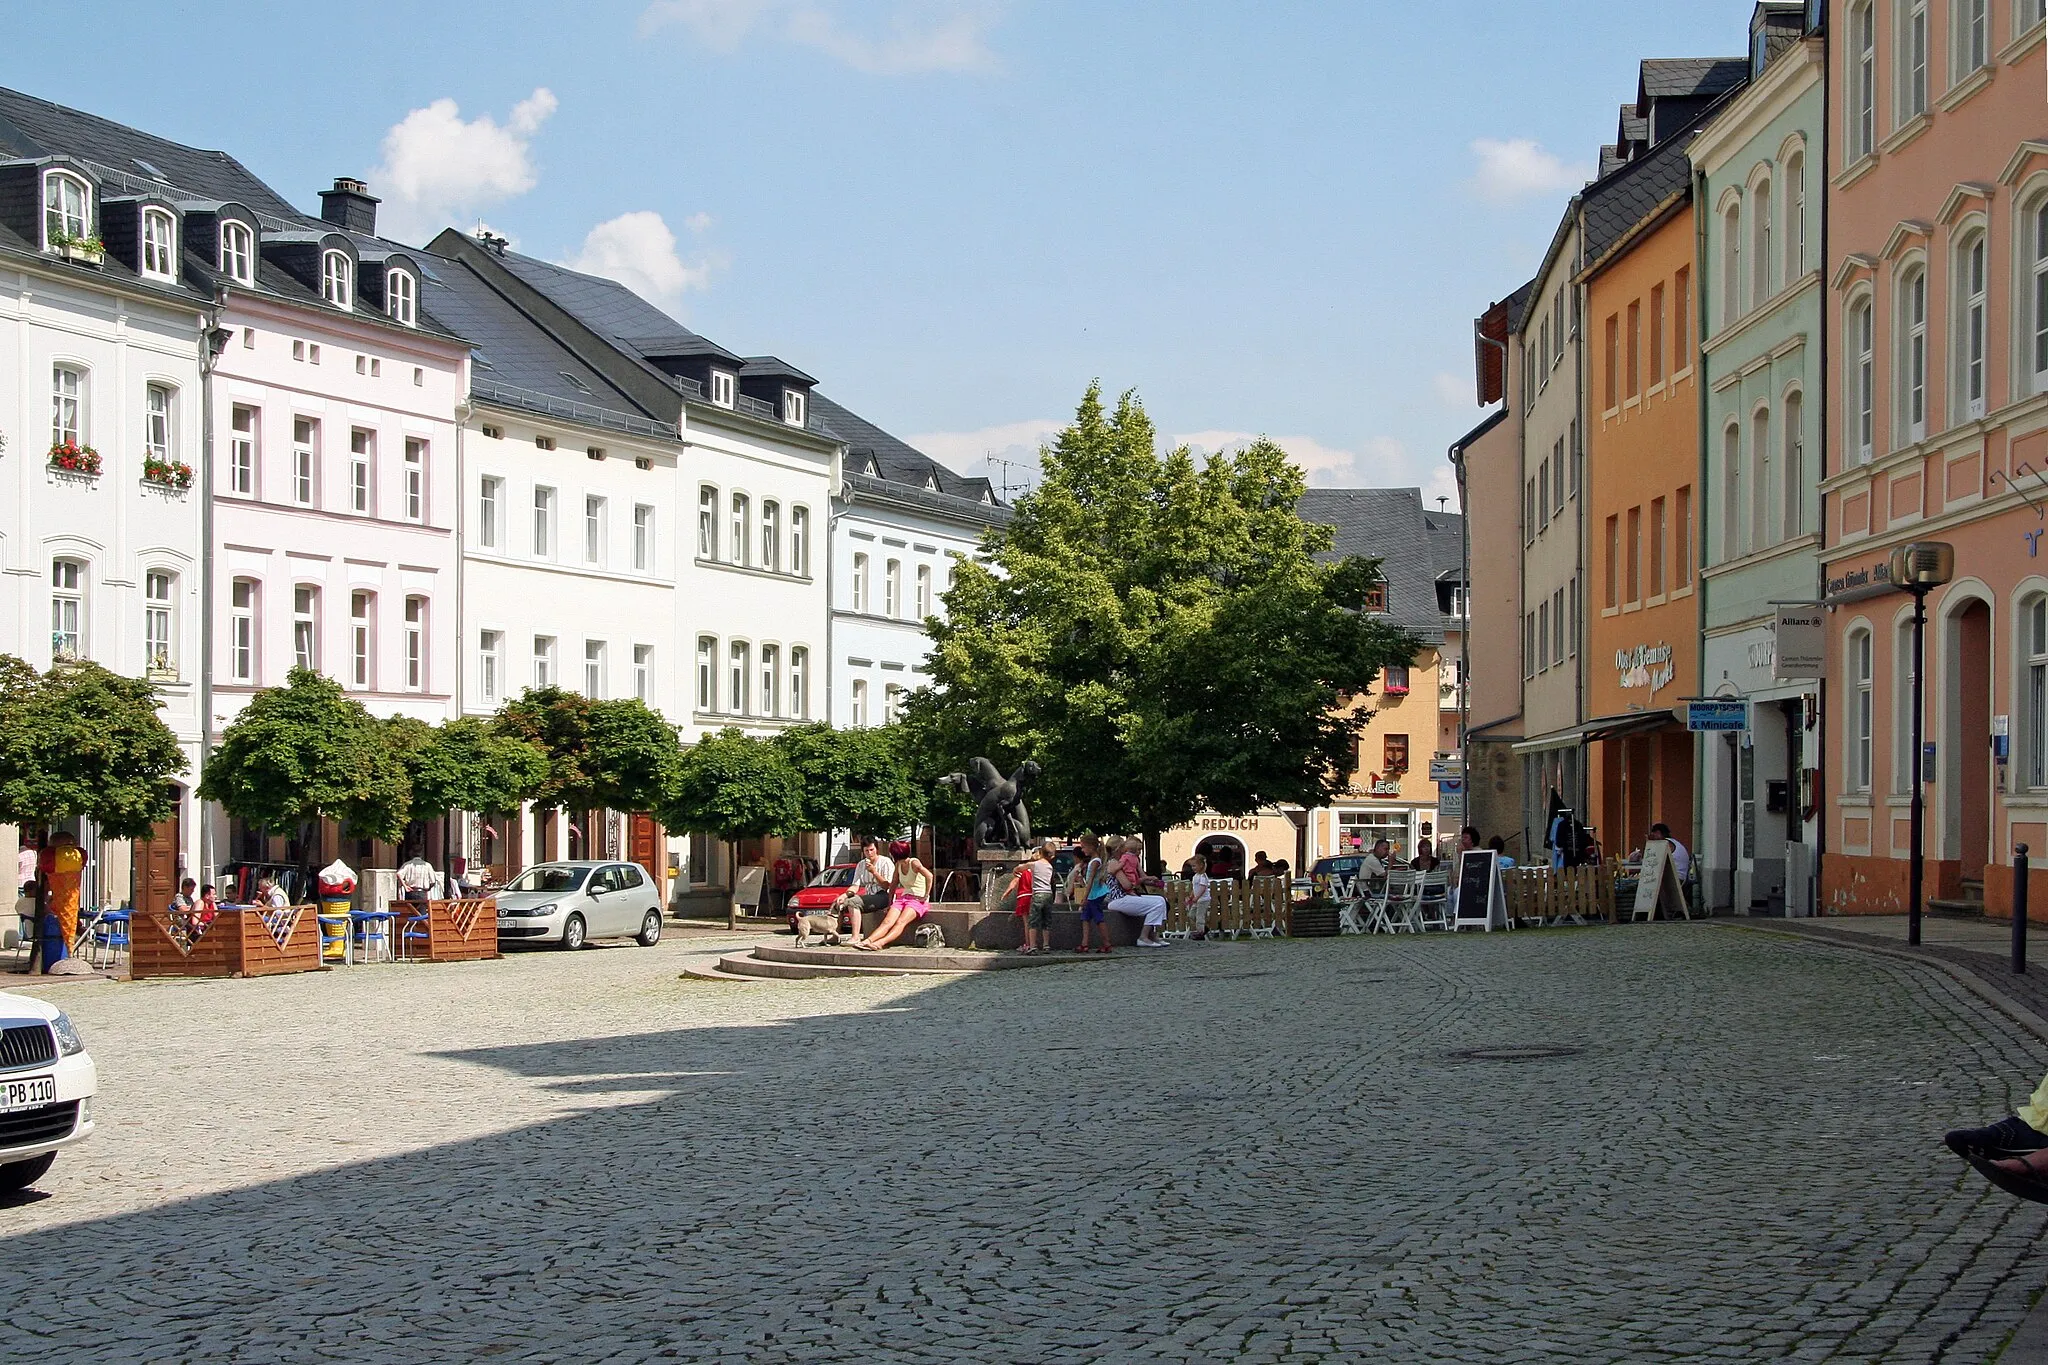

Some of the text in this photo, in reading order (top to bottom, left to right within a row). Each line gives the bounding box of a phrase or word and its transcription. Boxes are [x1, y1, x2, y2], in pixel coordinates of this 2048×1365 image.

[1782, 618, 1809, 626] Allianz
[1690, 720, 1744, 730] & Minicafe
[9, 1080, 53, 1105] PB 110
